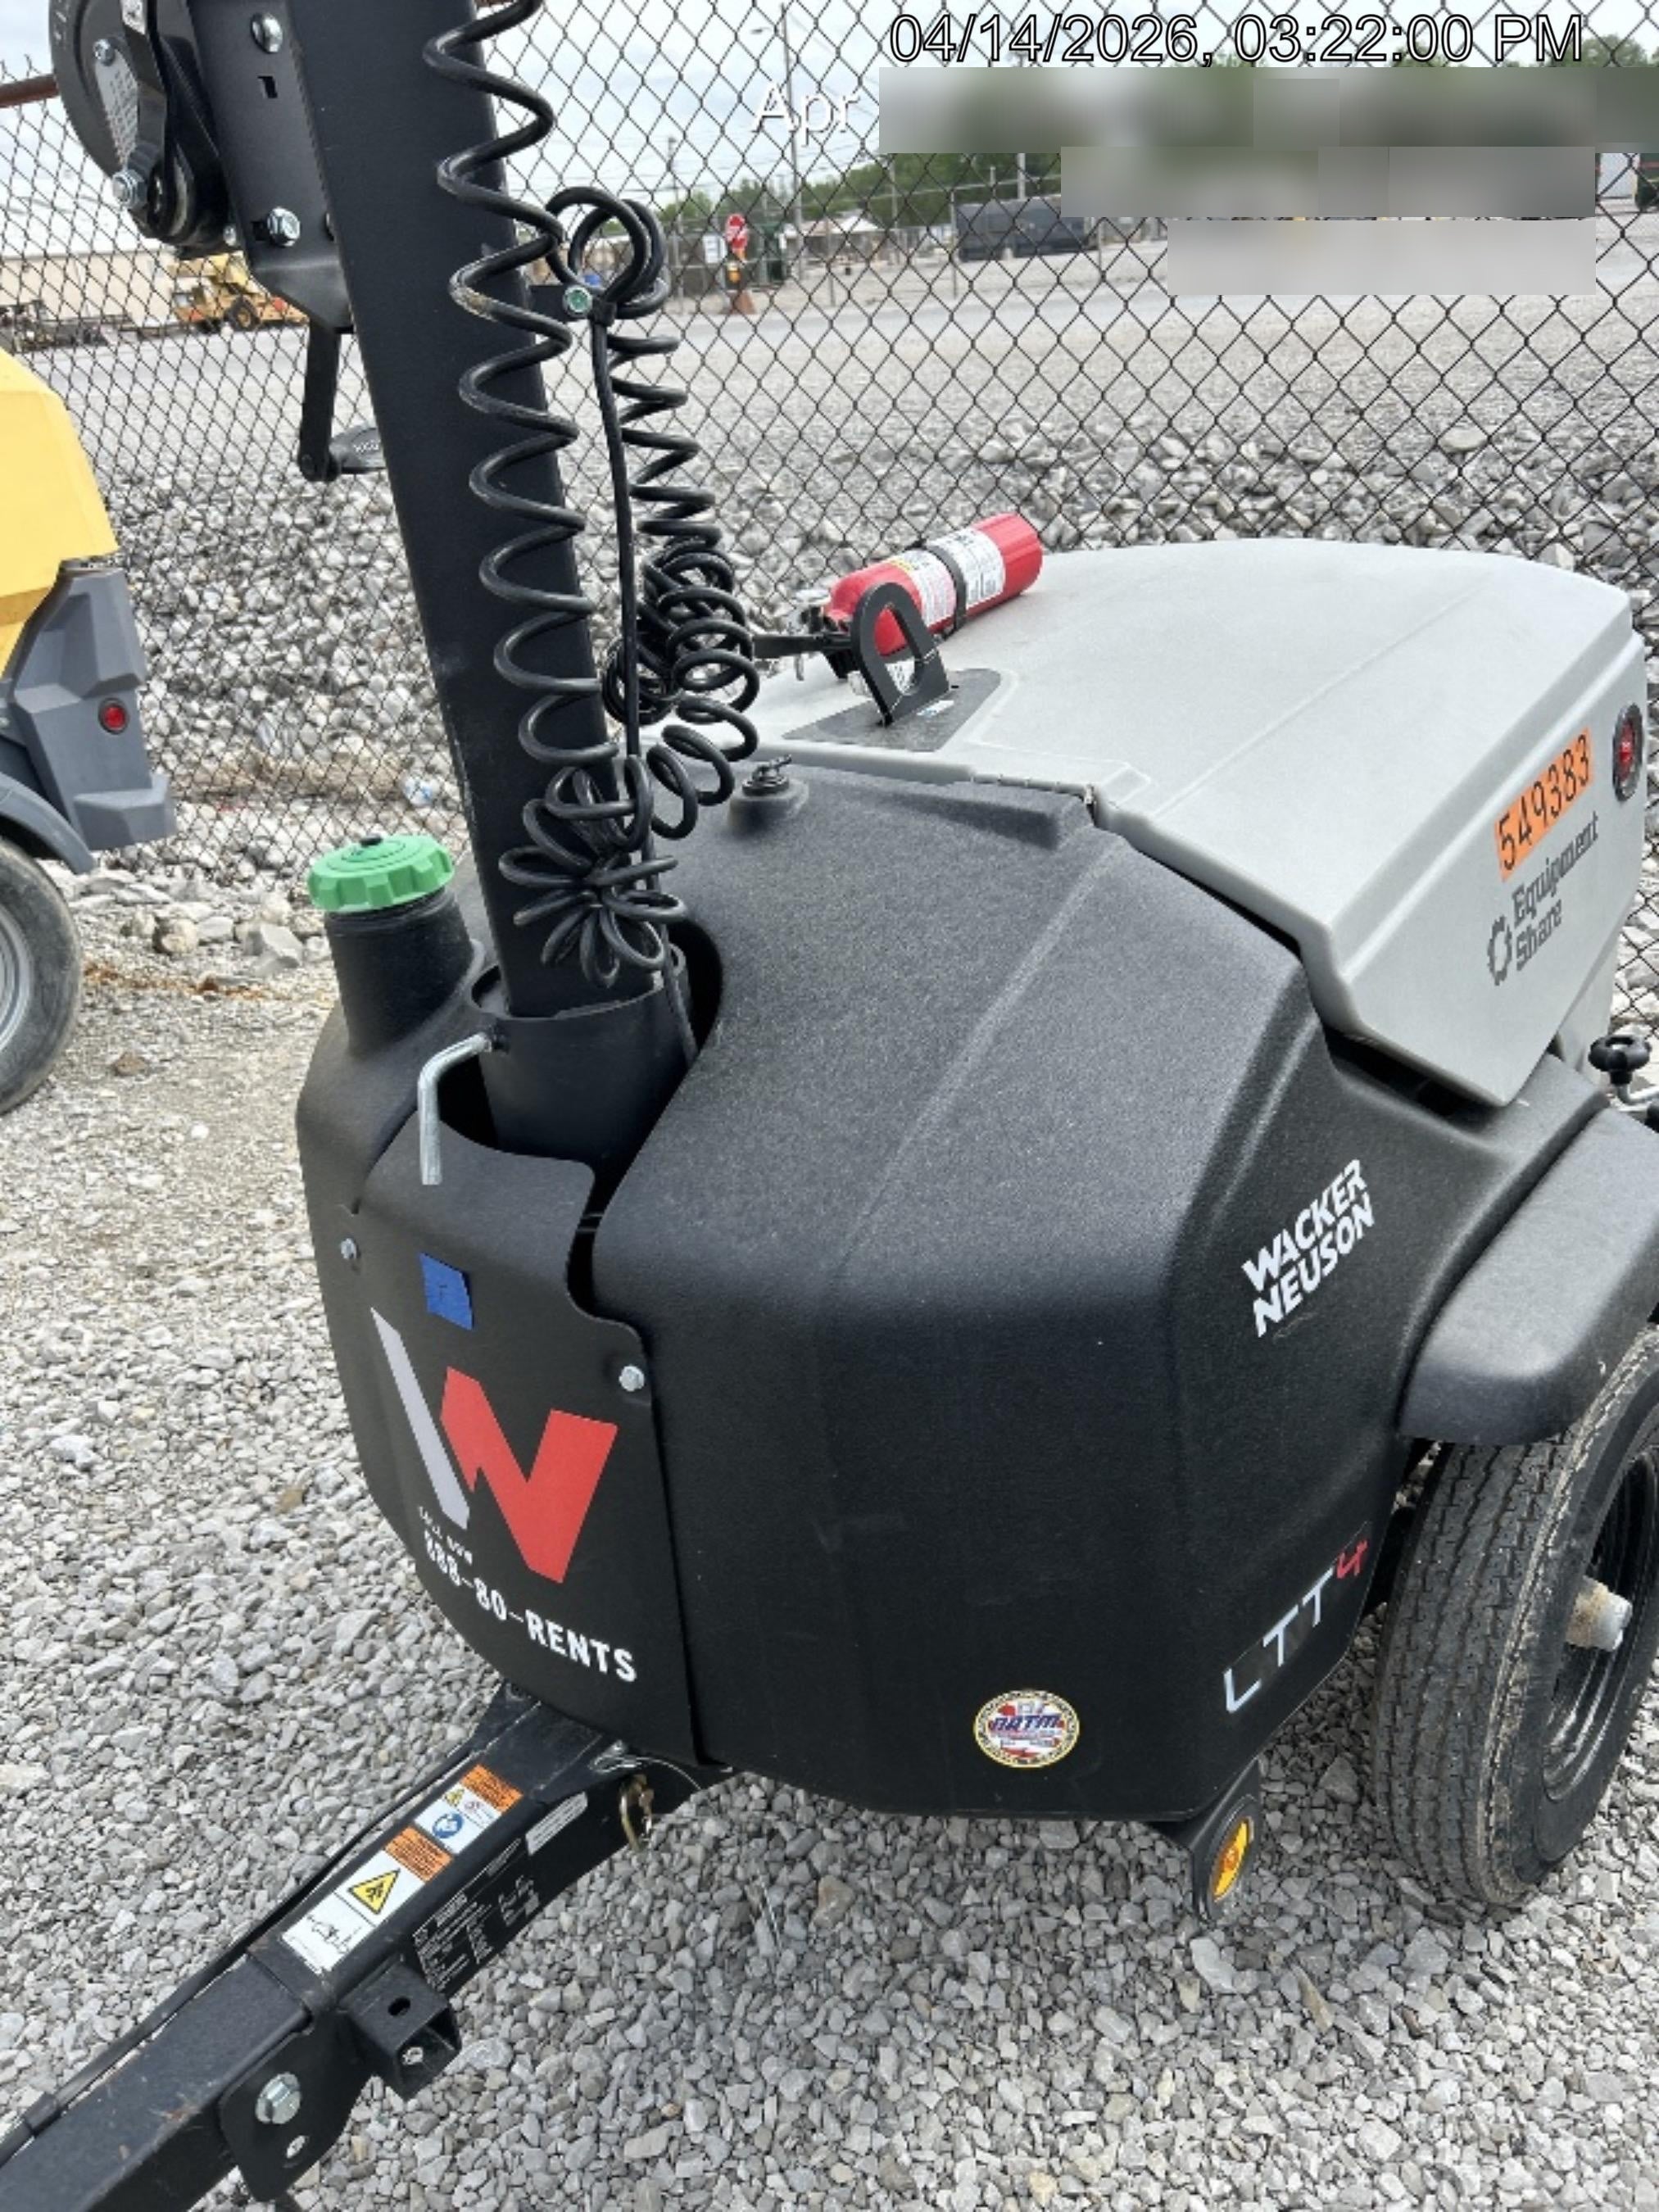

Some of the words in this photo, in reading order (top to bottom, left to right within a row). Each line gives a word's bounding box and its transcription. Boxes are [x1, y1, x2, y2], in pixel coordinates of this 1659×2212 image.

[1498, 733, 1590, 871] 549383
[1512, 810, 1599, 928] Equipment
[1516, 899, 1562, 972] Share
[1241, 1159, 1367, 1291] WACKER
[1253, 1192, 1375, 1338] NEUSON
